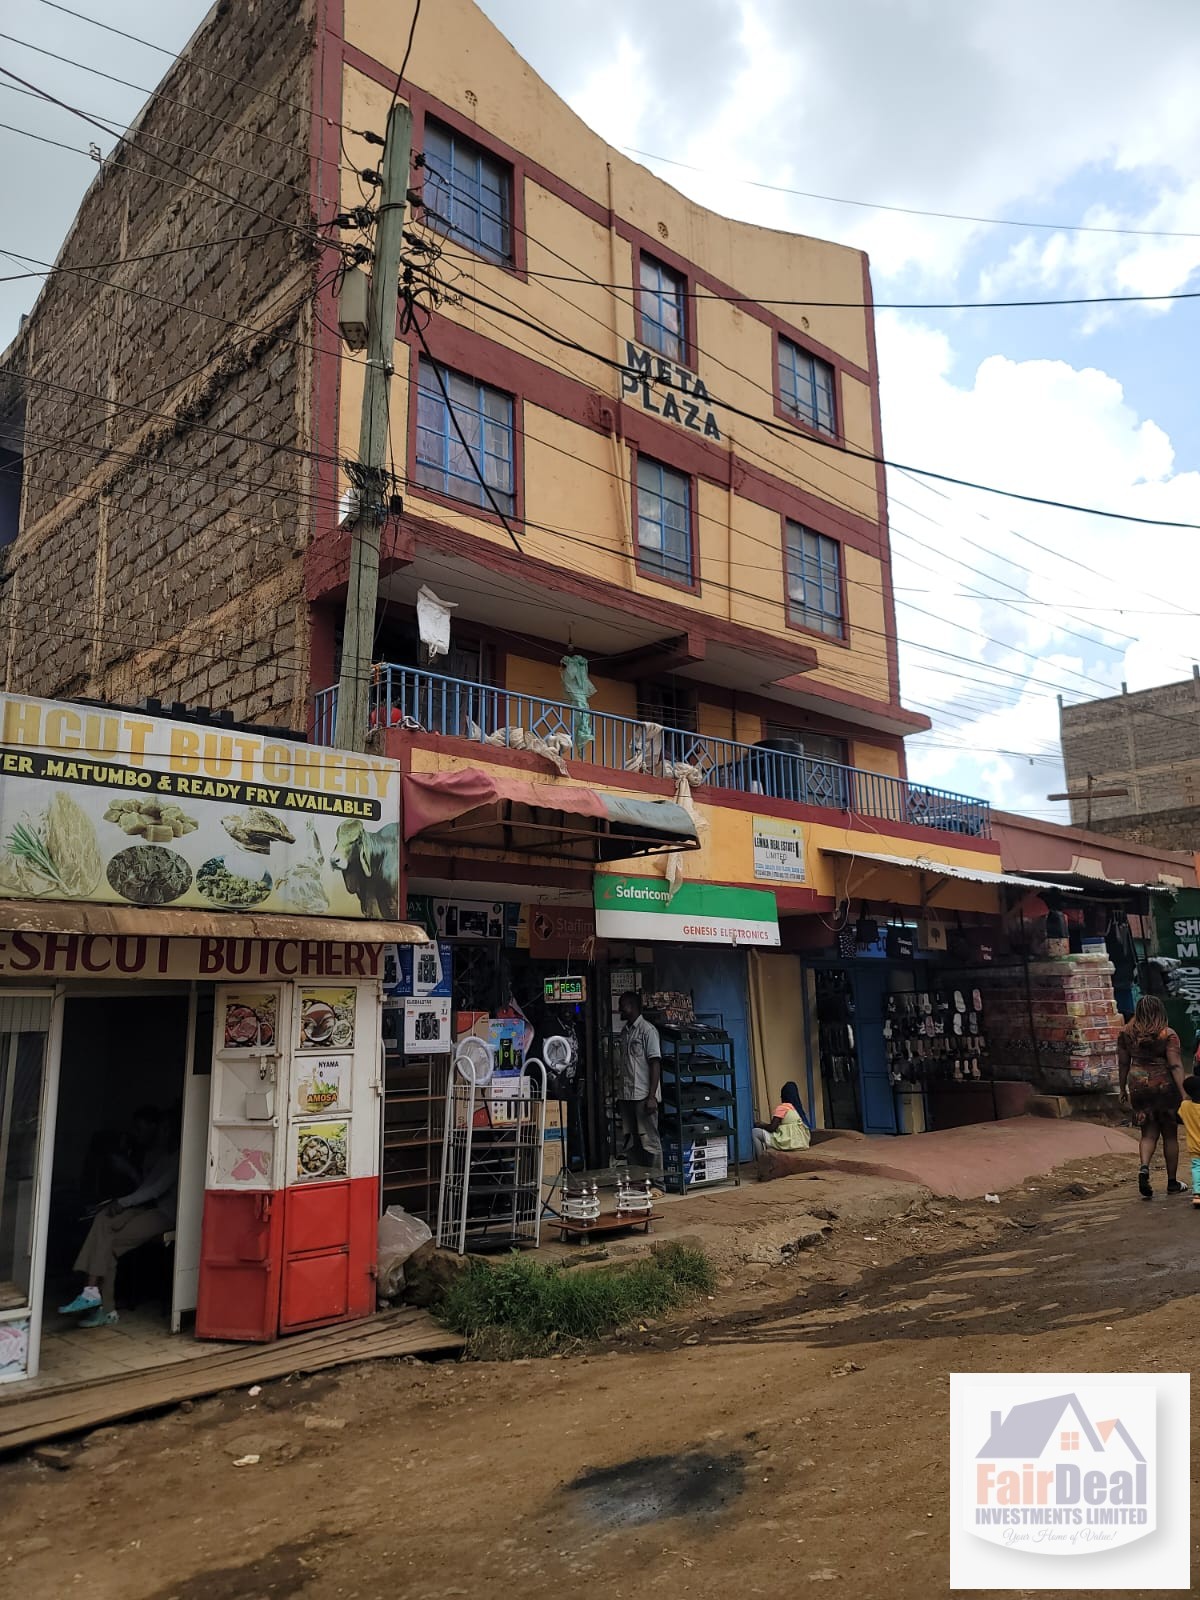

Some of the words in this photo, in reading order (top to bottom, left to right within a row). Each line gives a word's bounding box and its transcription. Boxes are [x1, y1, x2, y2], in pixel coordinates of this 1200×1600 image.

[626, 341, 711, 406] META
[621, 370, 721, 440] PLAZA
[170, 727, 394, 798] BUTCHERY
[157, 774, 172, 791] &
[177, 778, 239, 799] READY
[246, 787, 282, 804] FRY
[284, 792, 374, 817] AVAILABLE
[616, 885, 671, 902] Safaricom
[683, 925, 718, 937] GENESIS
[720, 928, 769, 940] ELECTRONICS
[1174, 919, 1200, 937] SH
[0, 931, 170, 973] SHCUT
[199, 937, 384, 977] BUTCHERY
[318, 1060, 339, 1069] NYAMA
